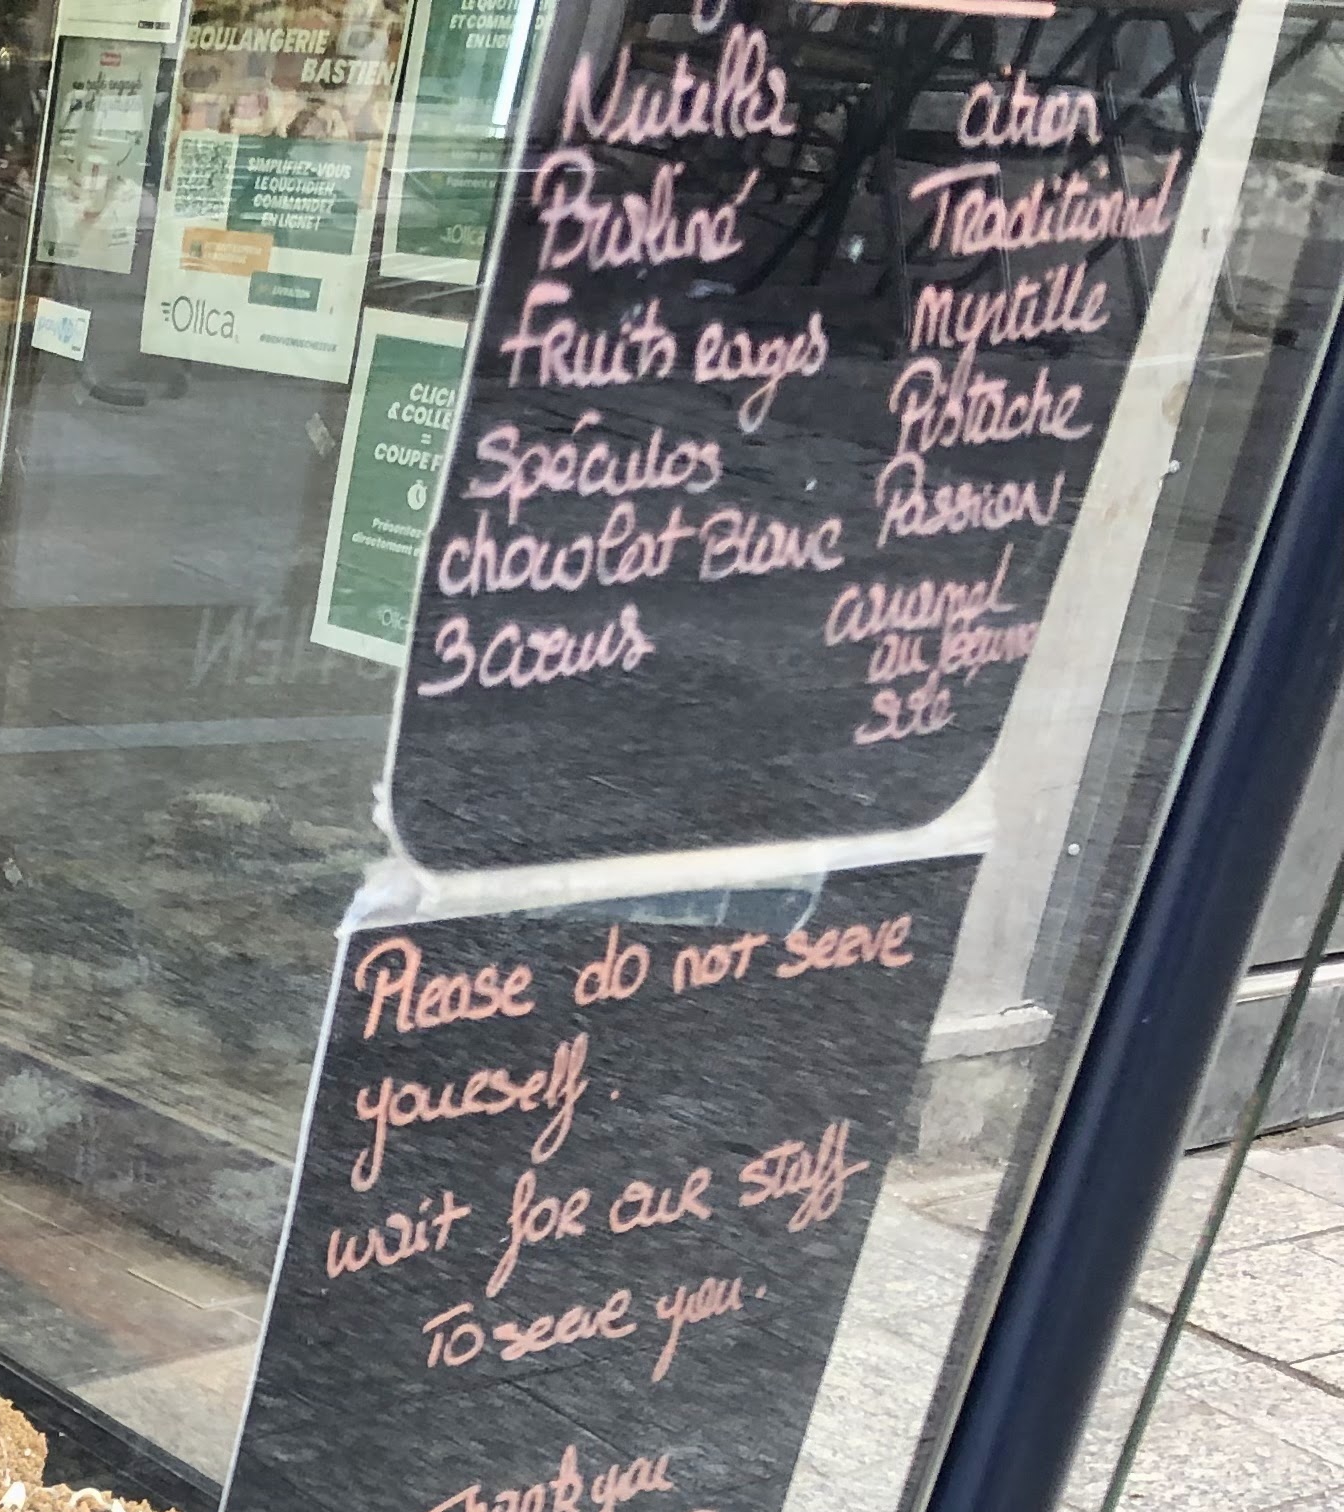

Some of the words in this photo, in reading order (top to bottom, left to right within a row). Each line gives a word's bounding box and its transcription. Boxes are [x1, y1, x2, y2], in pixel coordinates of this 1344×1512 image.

[186, 26, 330, 54] BOULANGERIE
[301, 57, 397, 86] BASTIEN
[562, 22, 796, 145] Nutella
[374, 442, 431, 471] COUPE
[354, 936, 535, 1040] Please
[575, 925, 651, 1007] do
[674, 932, 769, 994] not
[325, 1189, 471, 1279] wait
[738, 1119, 871, 1233] staff
[422, 1301, 485, 1369] To
